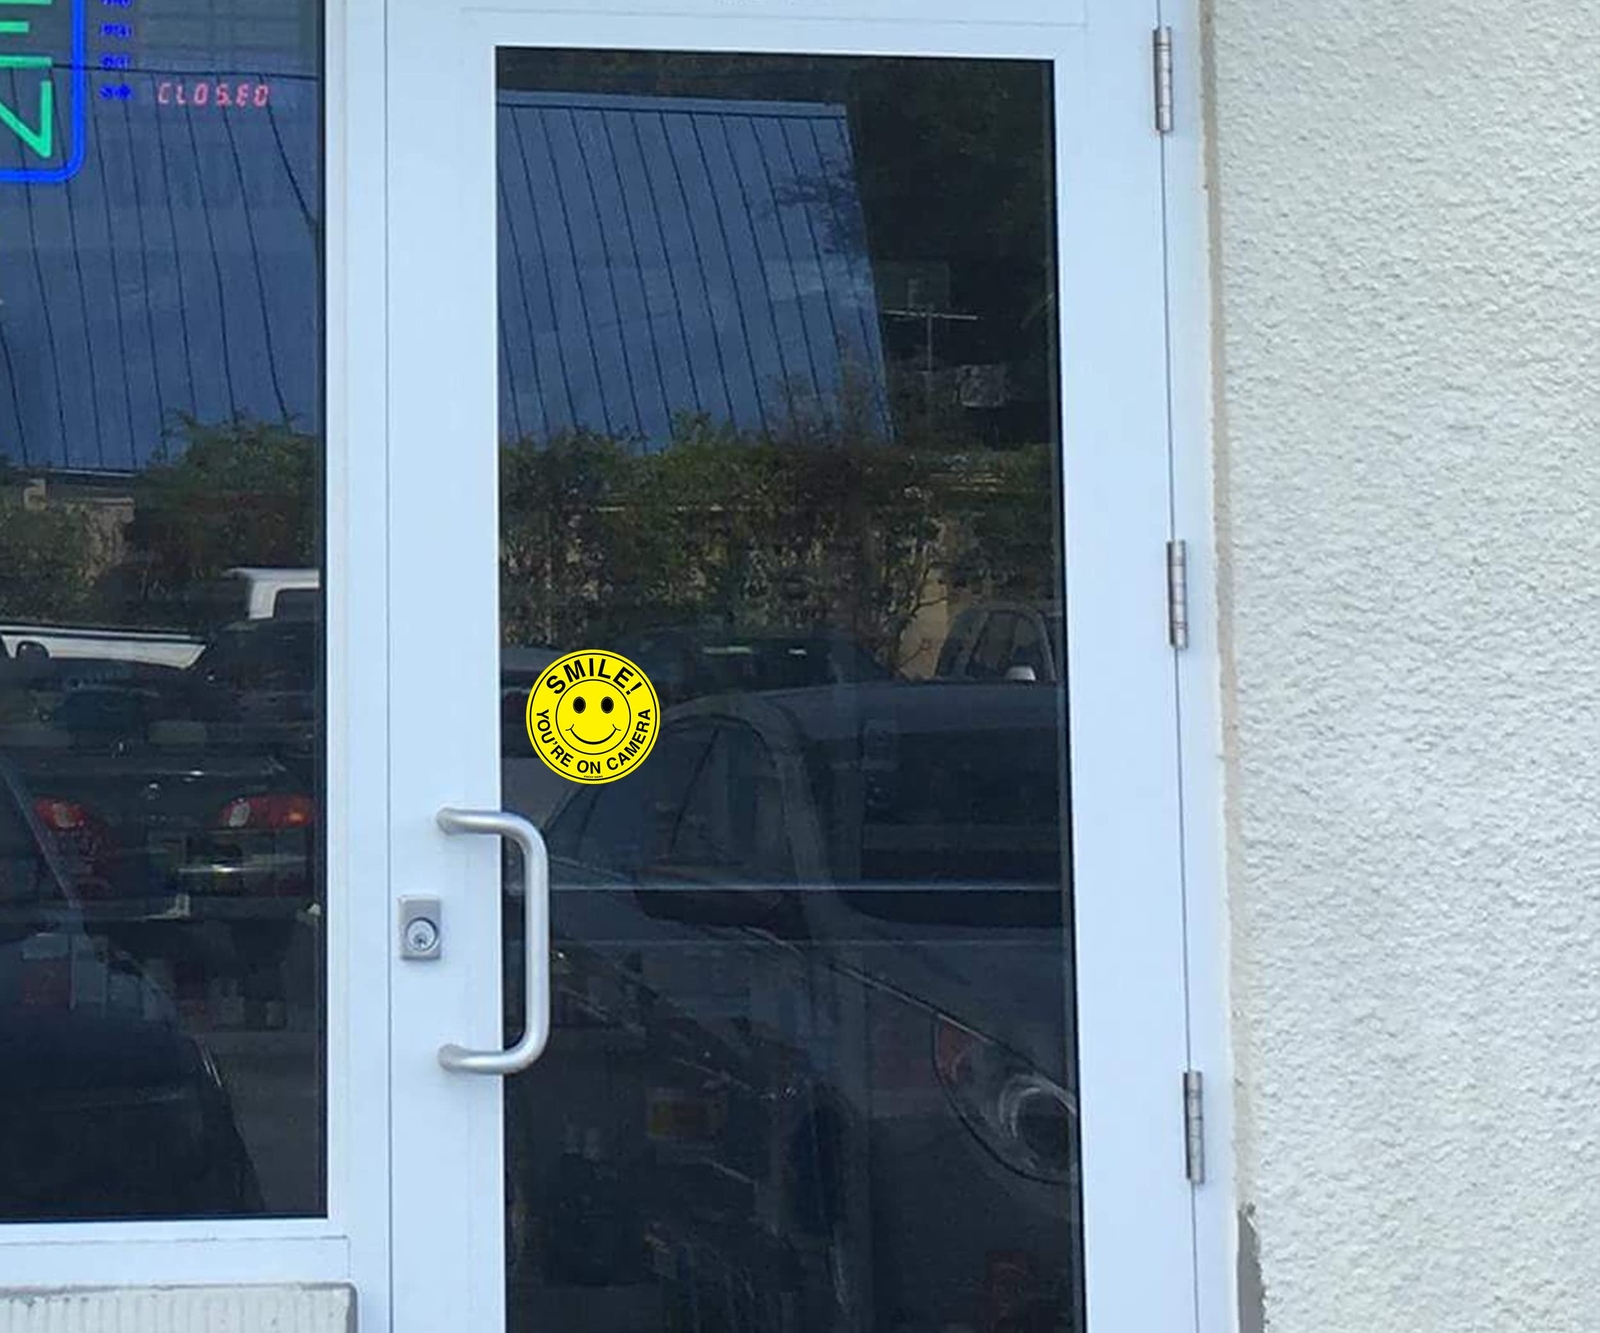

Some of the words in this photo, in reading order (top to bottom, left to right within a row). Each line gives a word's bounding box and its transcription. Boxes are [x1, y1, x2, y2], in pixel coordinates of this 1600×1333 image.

[157, 82, 269, 107] CLOSED
[546, 657, 643, 695] SMILE!
[536, 709, 574, 768] YOU'RE
[576, 759, 601, 775] ON
[606, 709, 651, 771] CAMERA
